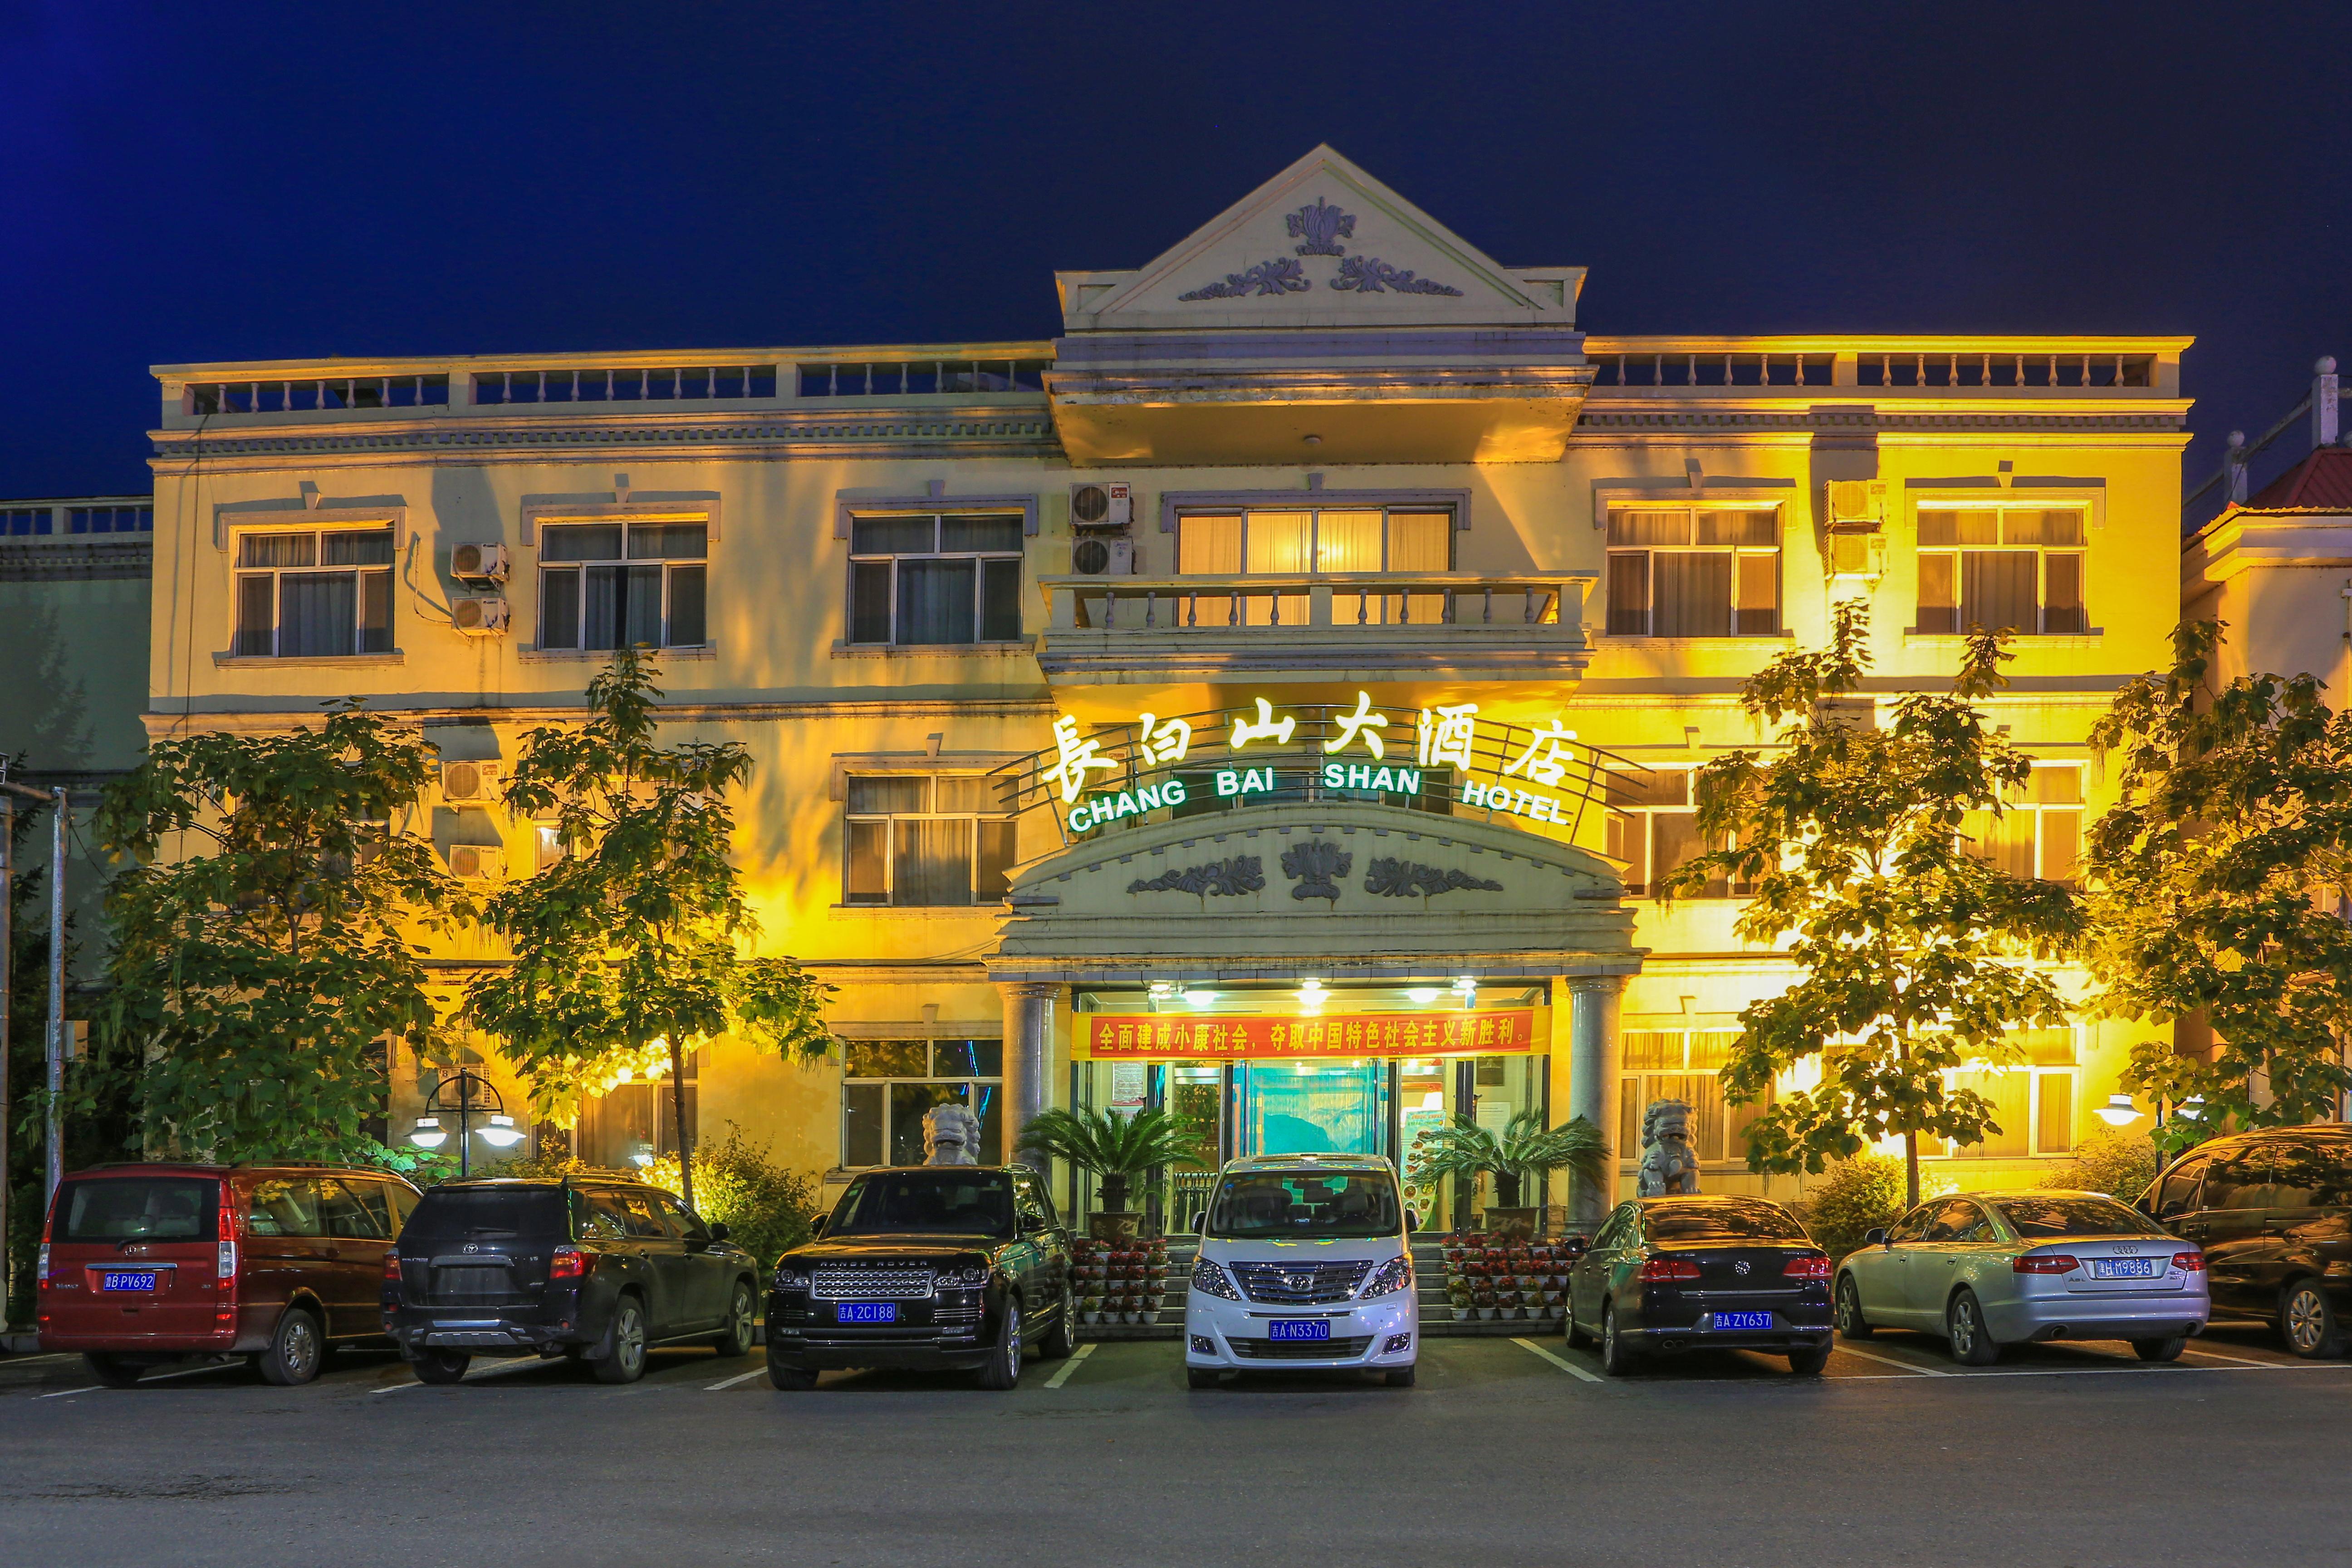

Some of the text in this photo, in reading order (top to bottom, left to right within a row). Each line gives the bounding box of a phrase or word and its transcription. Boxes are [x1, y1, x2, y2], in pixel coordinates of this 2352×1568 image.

[1069, 764, 1568, 832] CHANG BAI SHAN HOTEL
